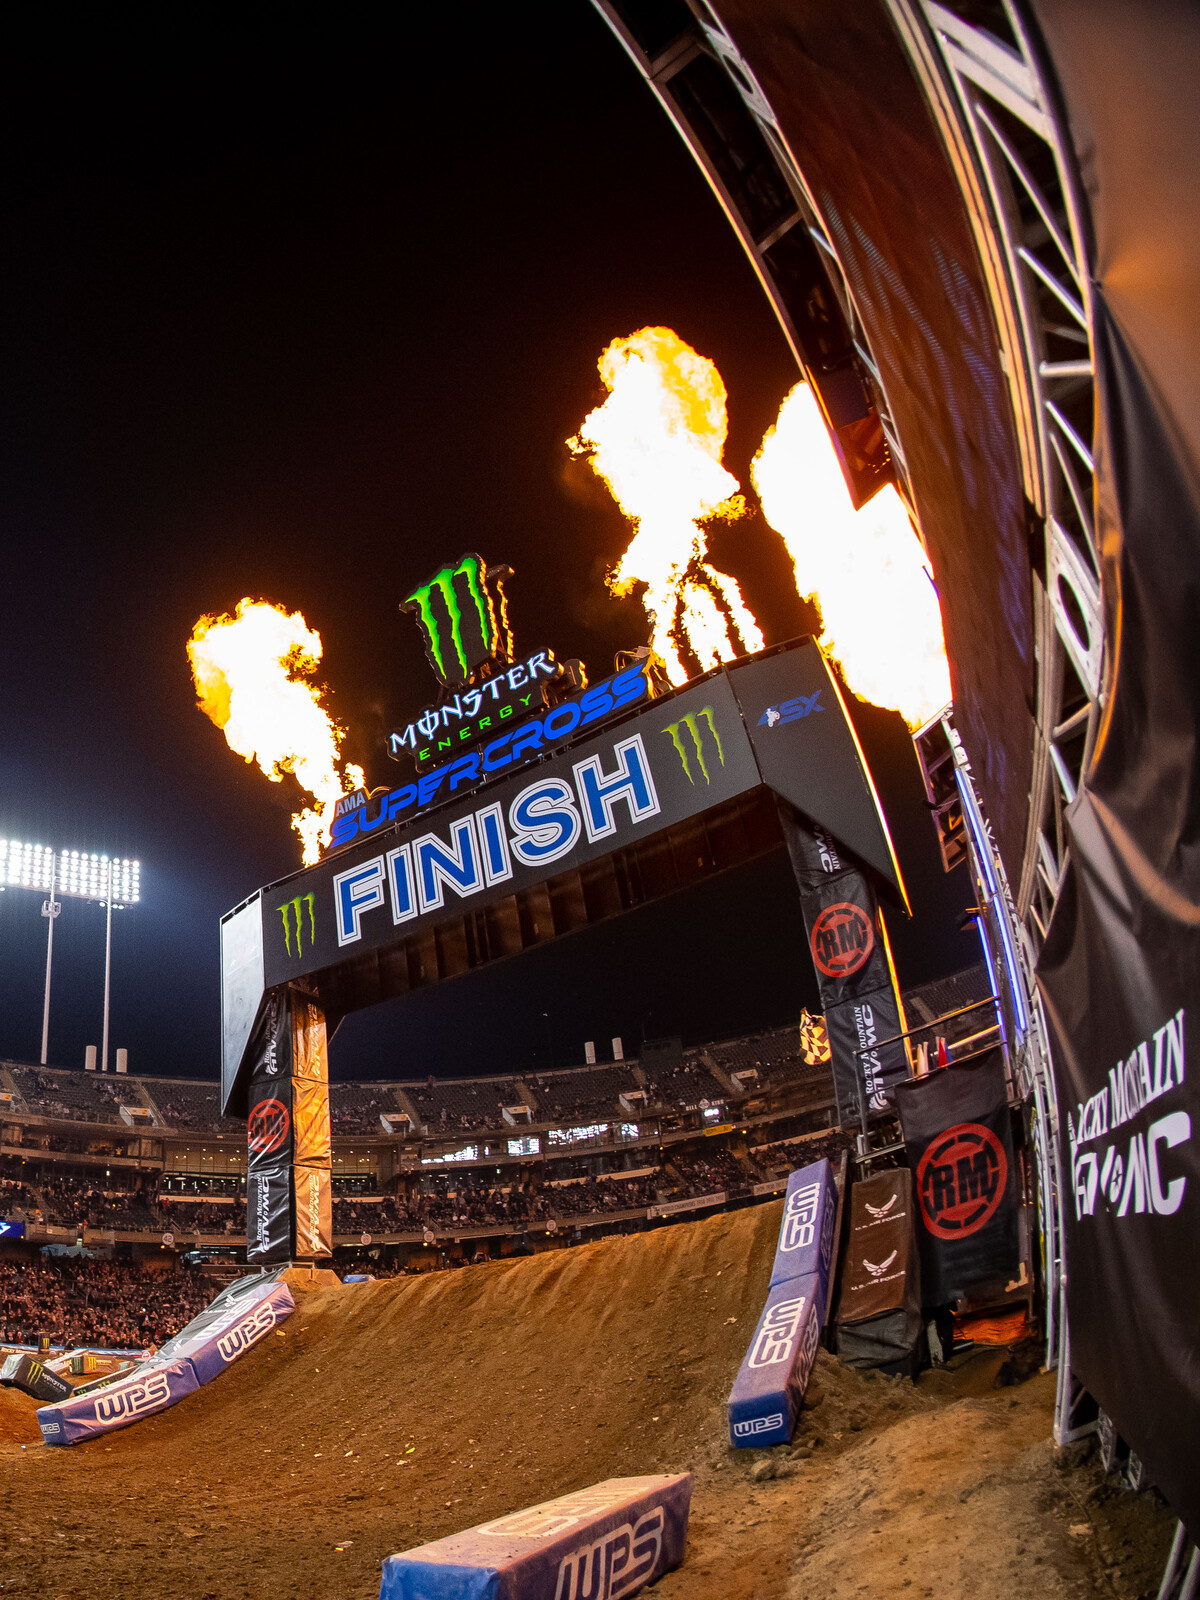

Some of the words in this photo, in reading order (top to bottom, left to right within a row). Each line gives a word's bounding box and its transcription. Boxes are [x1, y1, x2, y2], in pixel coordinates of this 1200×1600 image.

[389, 651, 556, 754] MONSTER
[418, 693, 532, 761] ENERGY
[329, 663, 647, 849] SUPERCROSS
[335, 792, 366, 818] AMA
[333, 733, 662, 947] FINISH
[863, 1062, 874, 1094] ROCKY
[780, 1182, 821, 1252] WPS
[217, 1302, 277, 1362] WPS
[748, 1296, 806, 1369] WPS
[94, 1373, 171, 1425] WPS
[734, 1413, 784, 1437] WPS
